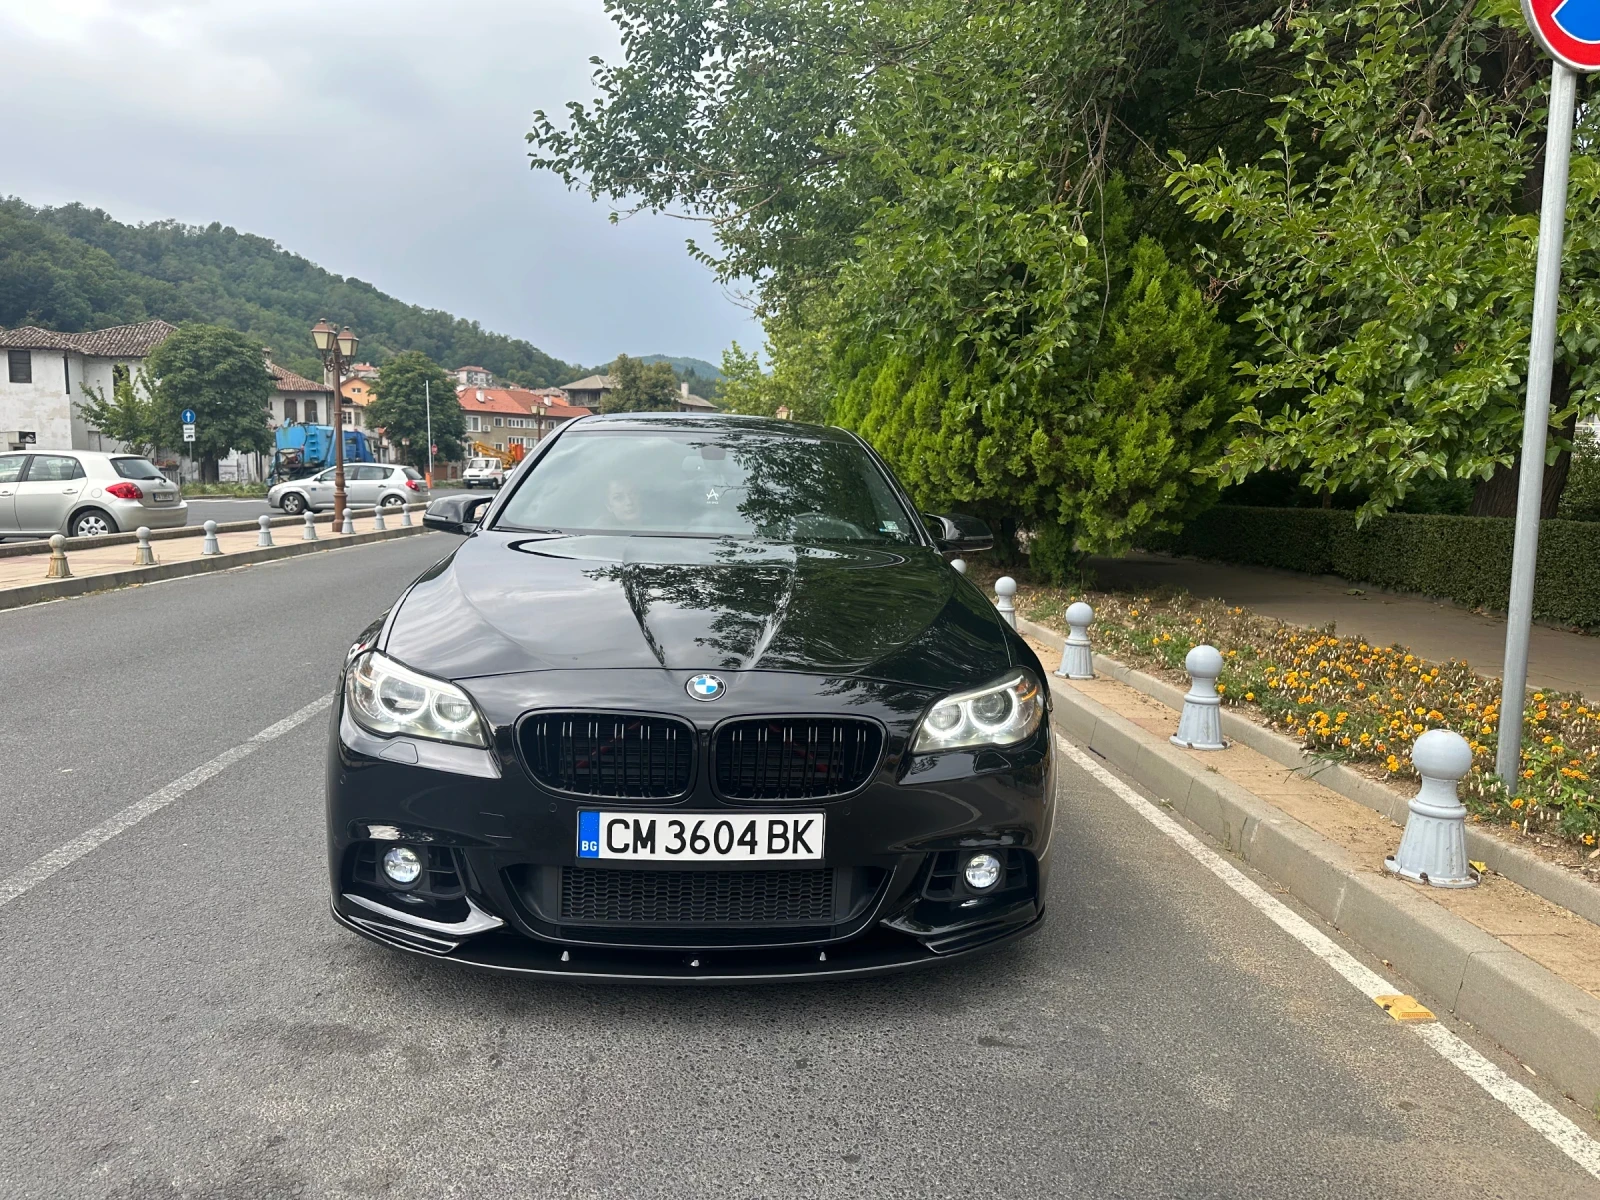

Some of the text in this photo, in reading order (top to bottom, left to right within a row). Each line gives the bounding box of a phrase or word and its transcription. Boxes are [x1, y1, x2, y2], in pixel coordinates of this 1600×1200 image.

[581, 841, 597, 851] BG
[607, 819, 815, 855] CM 3604 BK
